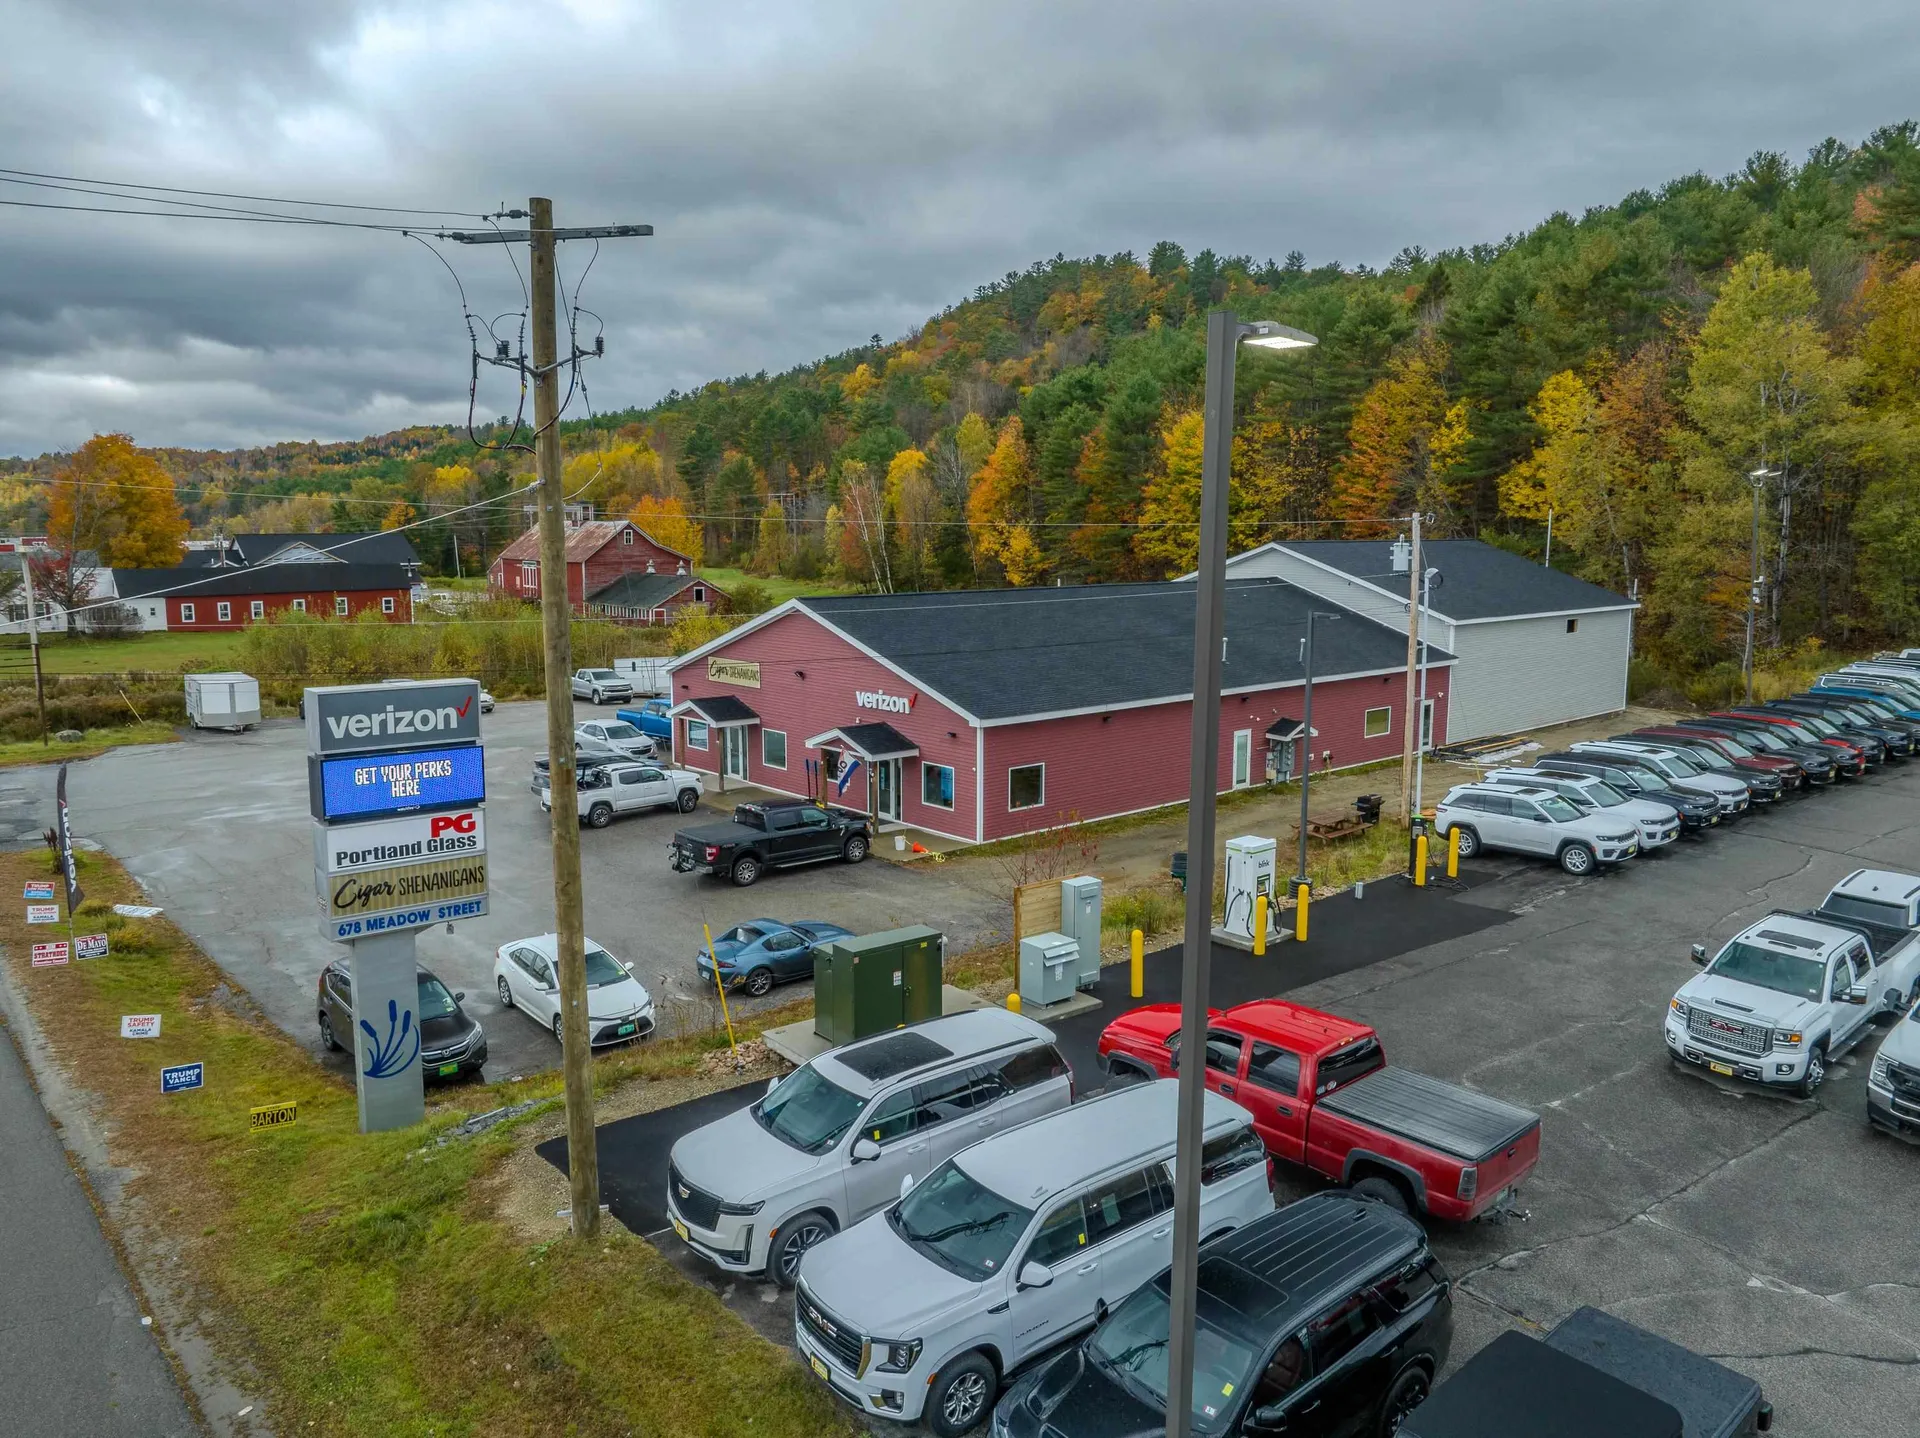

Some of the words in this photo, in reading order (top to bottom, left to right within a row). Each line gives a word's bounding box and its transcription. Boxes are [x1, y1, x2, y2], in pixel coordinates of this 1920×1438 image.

[855, 689, 911, 714] verizon
[326, 704, 459, 739] verizon
[354, 767, 377, 786] GET
[380, 762, 412, 783] YOUR
[415, 759, 452, 780] PERKS
[390, 779, 421, 798] HERE
[430, 813, 477, 839] PG
[336, 840, 423, 866] Portland
[426, 834, 477, 853] Glass
[333, 878, 397, 909] Cigar
[399, 865, 485, 896] SHENANIGANS
[337, 921, 362, 938] 678
[366, 909, 431, 932] MEADOW
[438, 900, 482, 920] STREET
[165, 1068, 201, 1080] TRUMP
[169, 1074, 197, 1085] VANCE
[251, 1107, 296, 1127] BARTON
[808, 1306, 838, 1337] GMC
